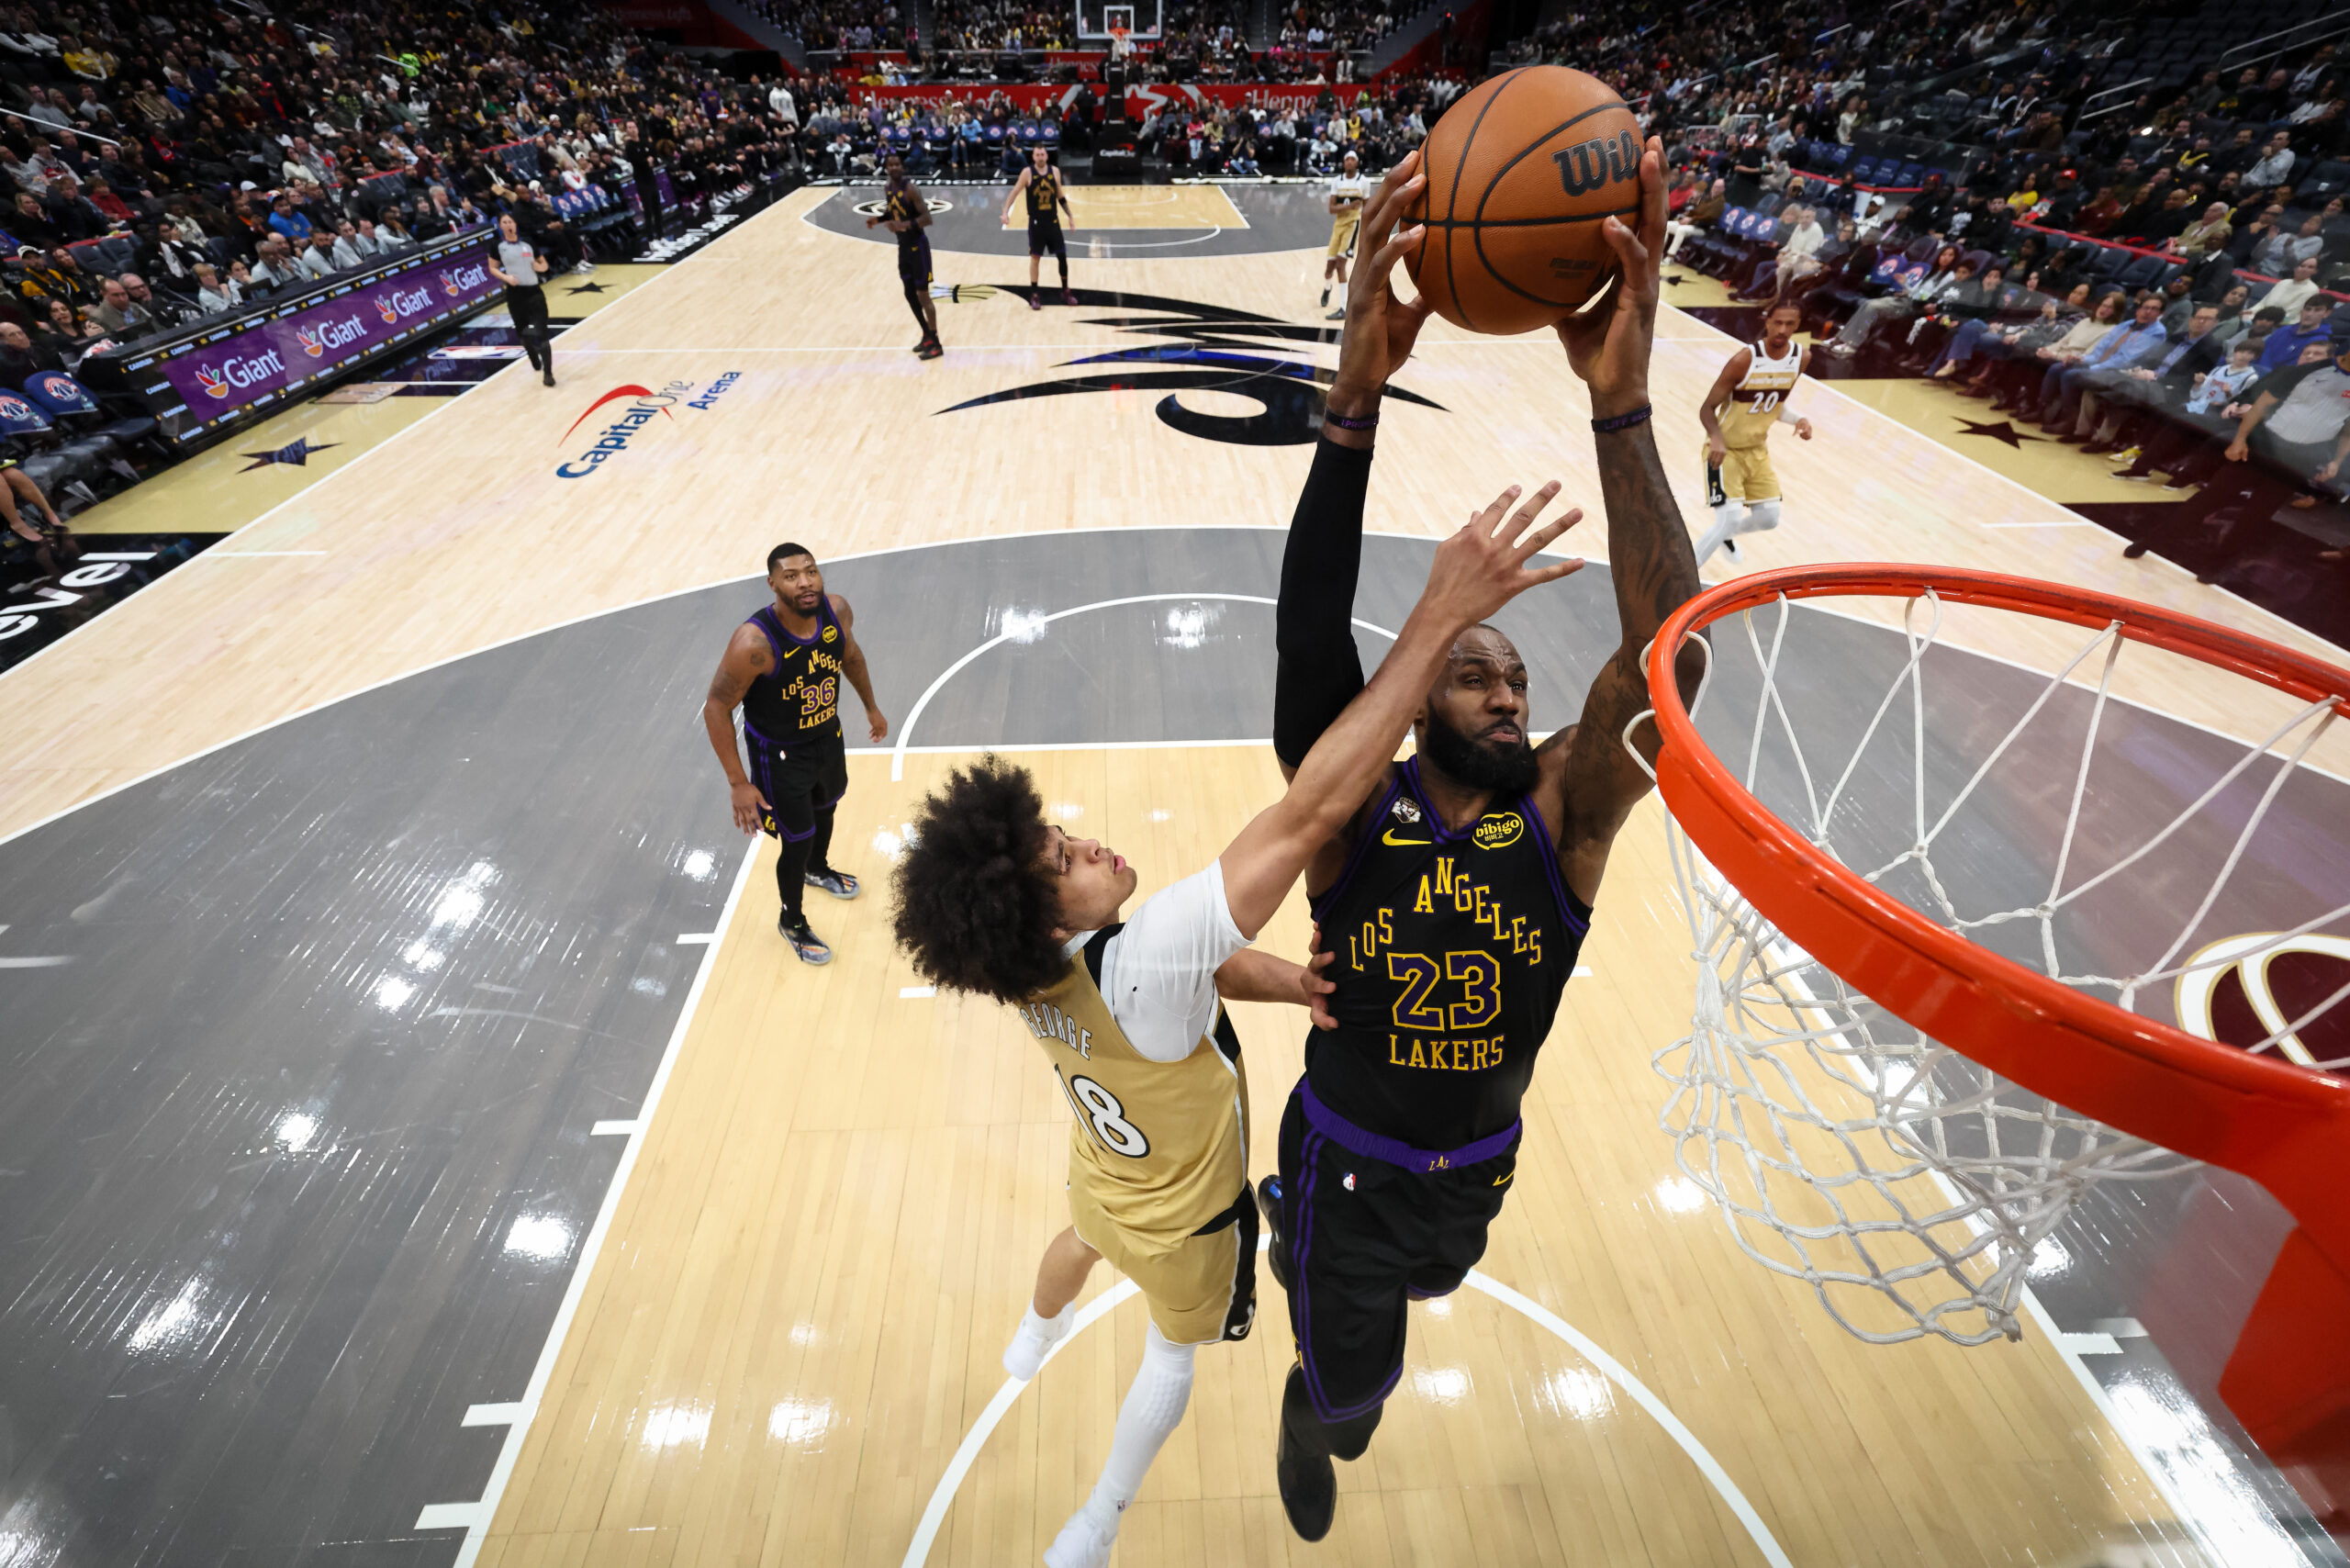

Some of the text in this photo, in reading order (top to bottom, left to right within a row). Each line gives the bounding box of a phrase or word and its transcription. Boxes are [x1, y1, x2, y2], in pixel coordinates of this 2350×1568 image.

[1252, 89, 1350, 111] Henney
[1552, 129, 1642, 197] Wil
[453, 263, 488, 291] Giant
[392, 286, 433, 317] Giant
[318, 314, 368, 349] Giant
[224, 348, 285, 388] Giant
[687, 371, 743, 410] Arena
[1748, 391, 1780, 414] 20
[782, 649, 842, 700] LOS ANGELE
[800, 676, 835, 715] 36
[799, 703, 836, 729] LAKERS
[1475, 819, 1520, 837] bibigo
[1349, 857, 1541, 972] LOS ANGELES
[1386, 949, 1502, 1032] 23
[1020, 1002, 1092, 1061] GEORGE
[1389, 1034, 1505, 1071] LAKERS
